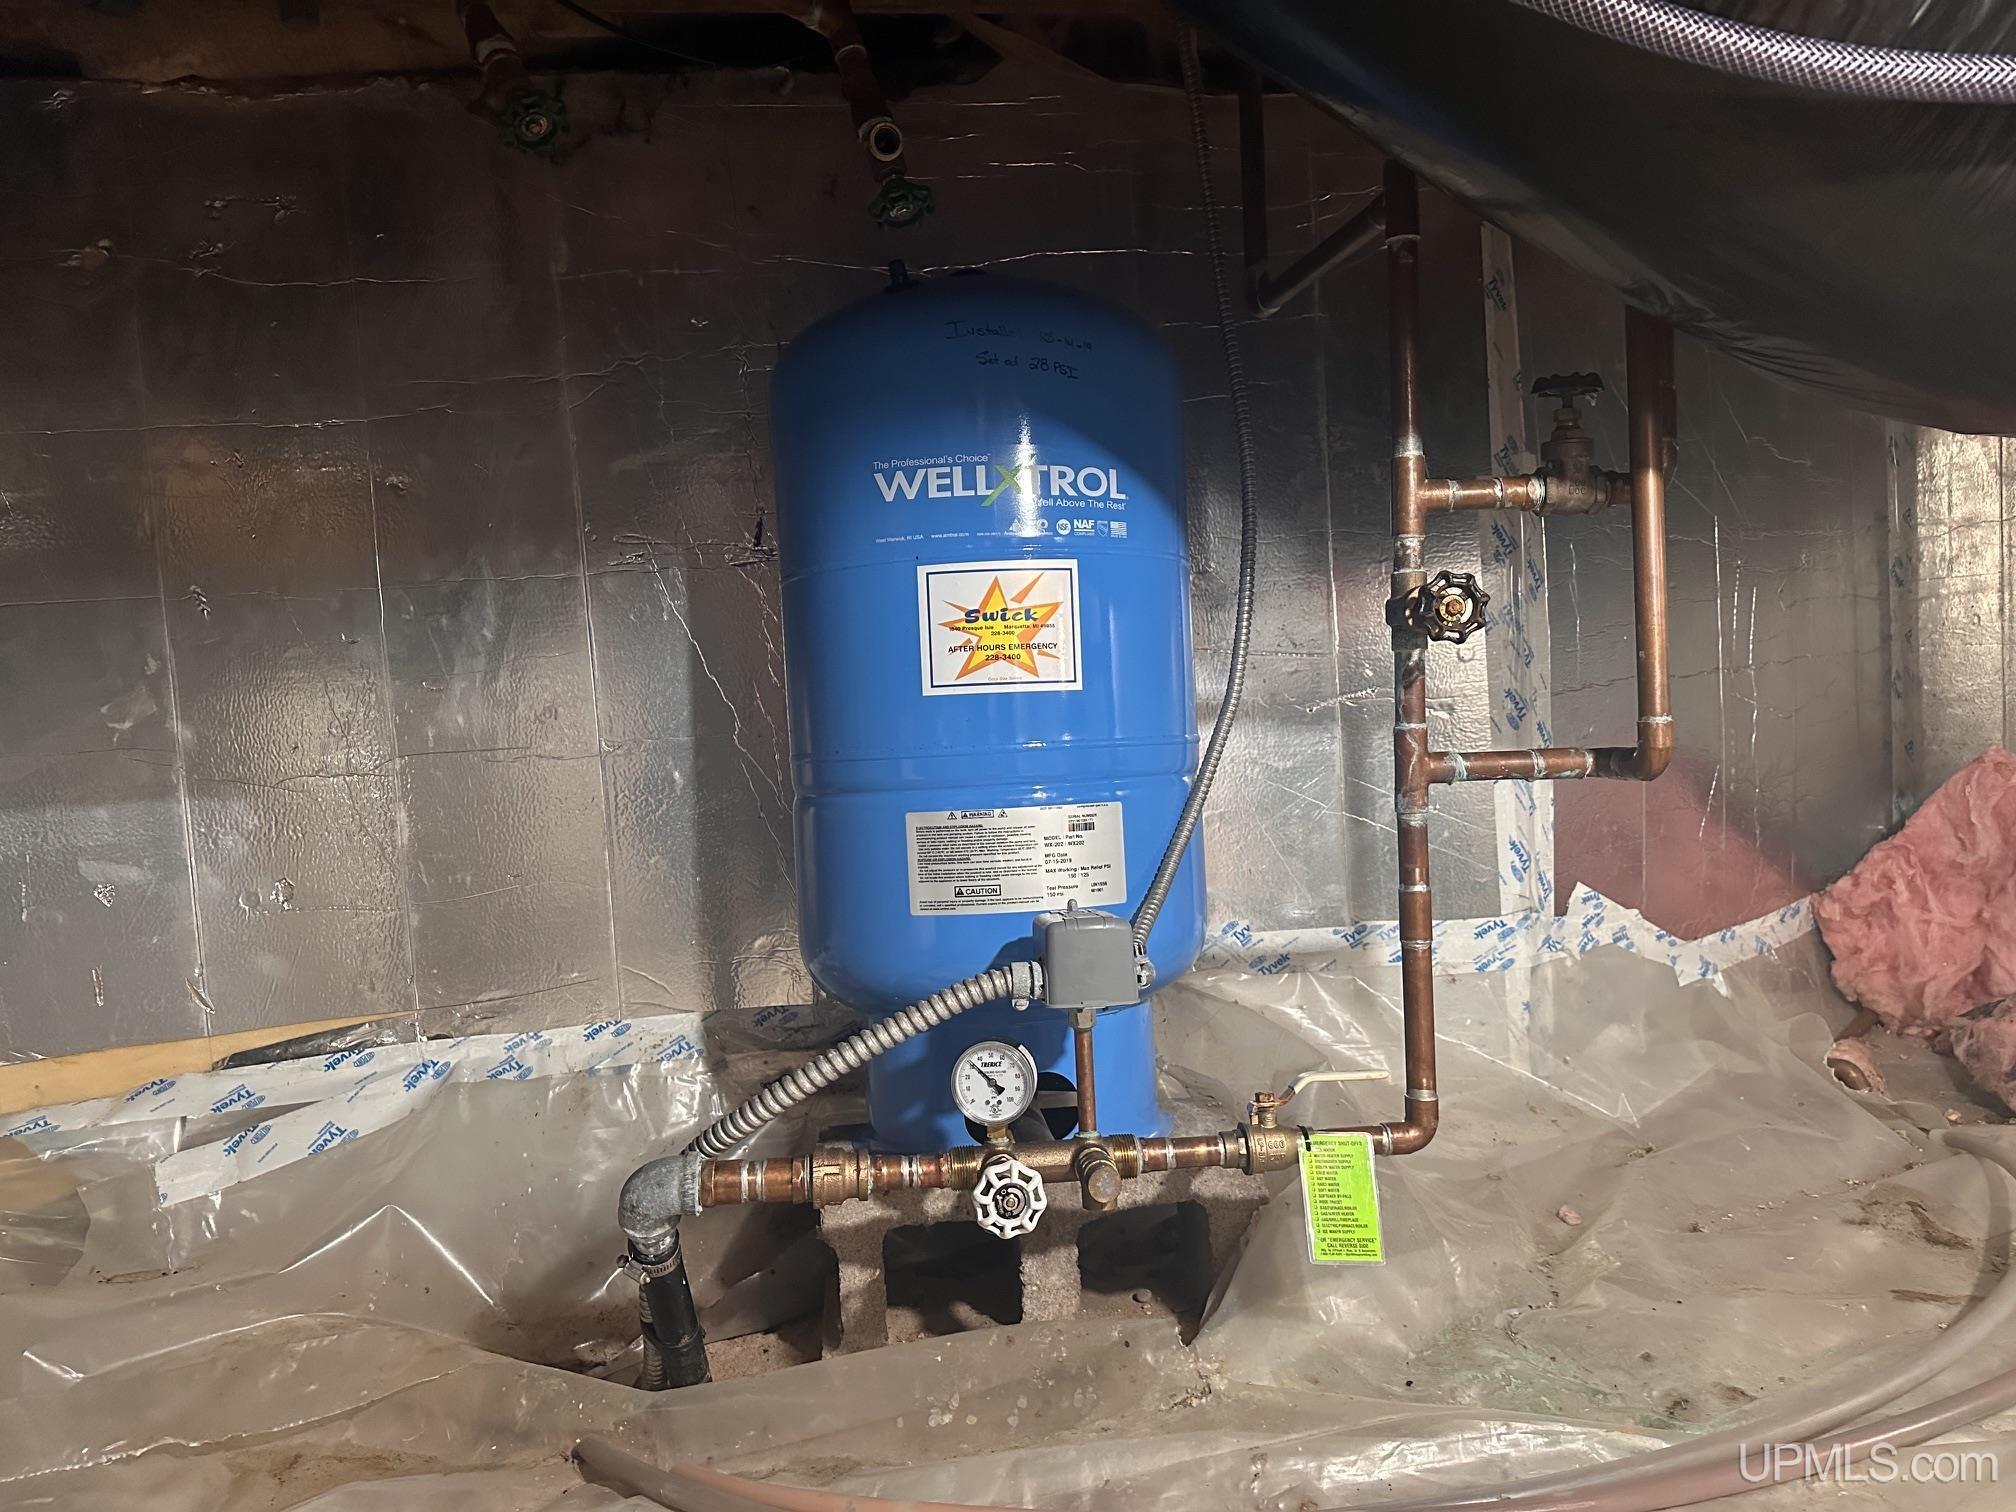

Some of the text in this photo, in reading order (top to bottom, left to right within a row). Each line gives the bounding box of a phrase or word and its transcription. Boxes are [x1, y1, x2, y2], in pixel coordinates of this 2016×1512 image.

[1029, 357, 1050, 371] 28
[1053, 361, 1079, 379] PSI
[873, 461, 889, 470] The
[891, 456, 953, 468] Professional's
[1055, 498, 1086, 508] Above
[1088, 499, 1104, 508] The
[1107, 500, 1126, 510] Rest
[1074, 518, 1095, 529] NAF
[964, 607, 1039, 624] Swick
[948, 642, 1058, 653] AFTER HOURS EMERGENCY
[985, 653, 1021, 661] 228-3400
[965, 887, 998, 895] CAUTION
[1258, 952, 1291, 976] Tyvek
[402, 1058, 440, 1093] Tyvek
[210, 1086, 256, 1114] Tyvek
